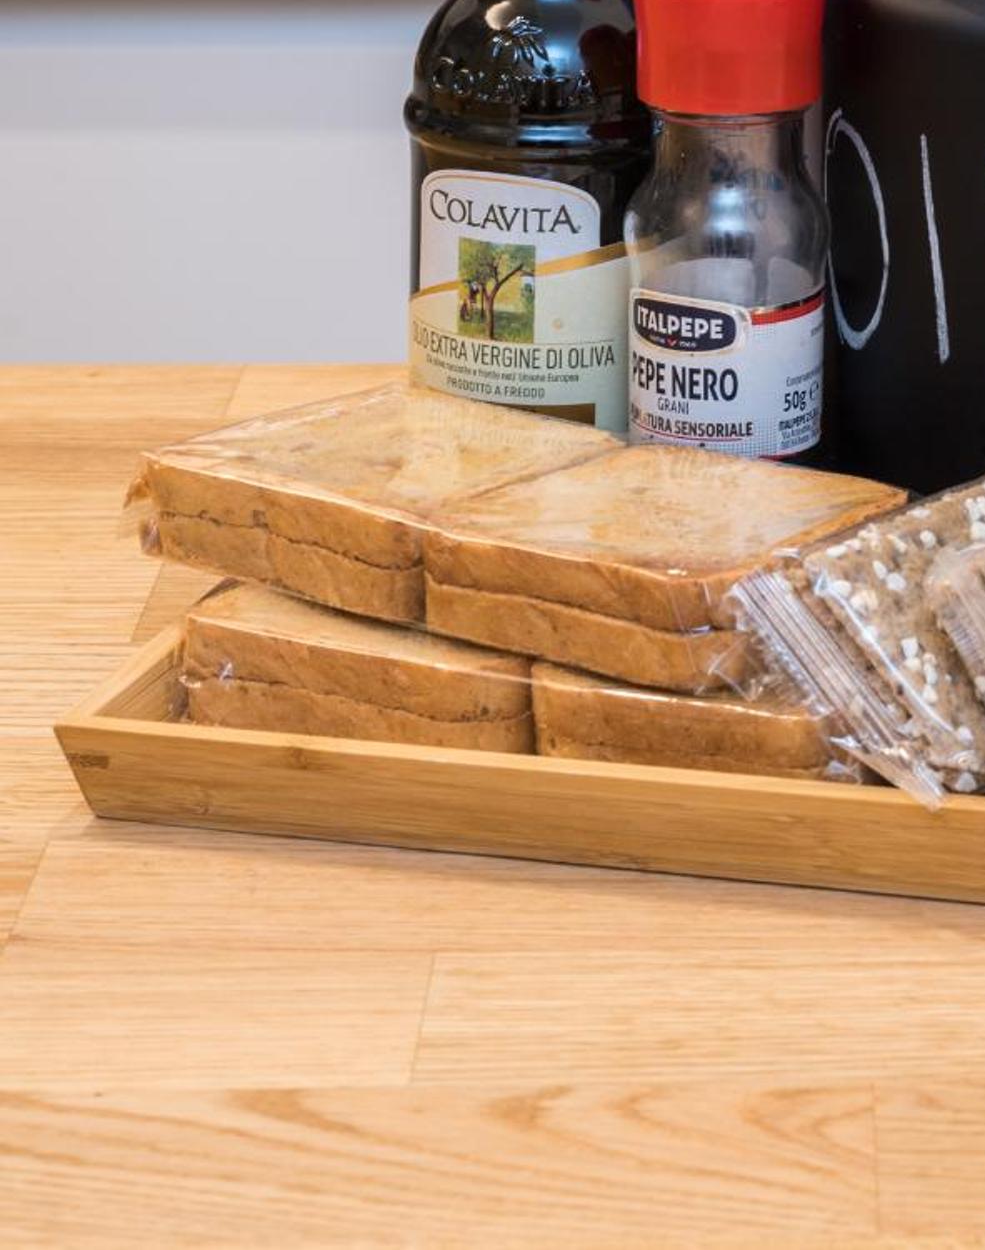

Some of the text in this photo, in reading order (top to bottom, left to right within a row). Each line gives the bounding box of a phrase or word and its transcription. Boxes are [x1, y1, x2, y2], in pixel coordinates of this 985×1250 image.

[429, 188, 580, 234] COLAVITA
[636, 304, 725, 340] ITALPEPE
[430, 331, 468, 361] EXTRA
[470, 342, 541, 370] VERGINE
[545, 348, 563, 370] DI
[567, 345, 616, 370] OLIVA
[446, 376, 546, 399] PRODOTTO A FREDDO
[632, 350, 666, 396] PEPE
[671, 364, 739, 402] NERO
[657, 396, 690, 415] GRANI
[782, 390, 808, 412] 50g
[673, 420, 754, 438] SENSORIALE
